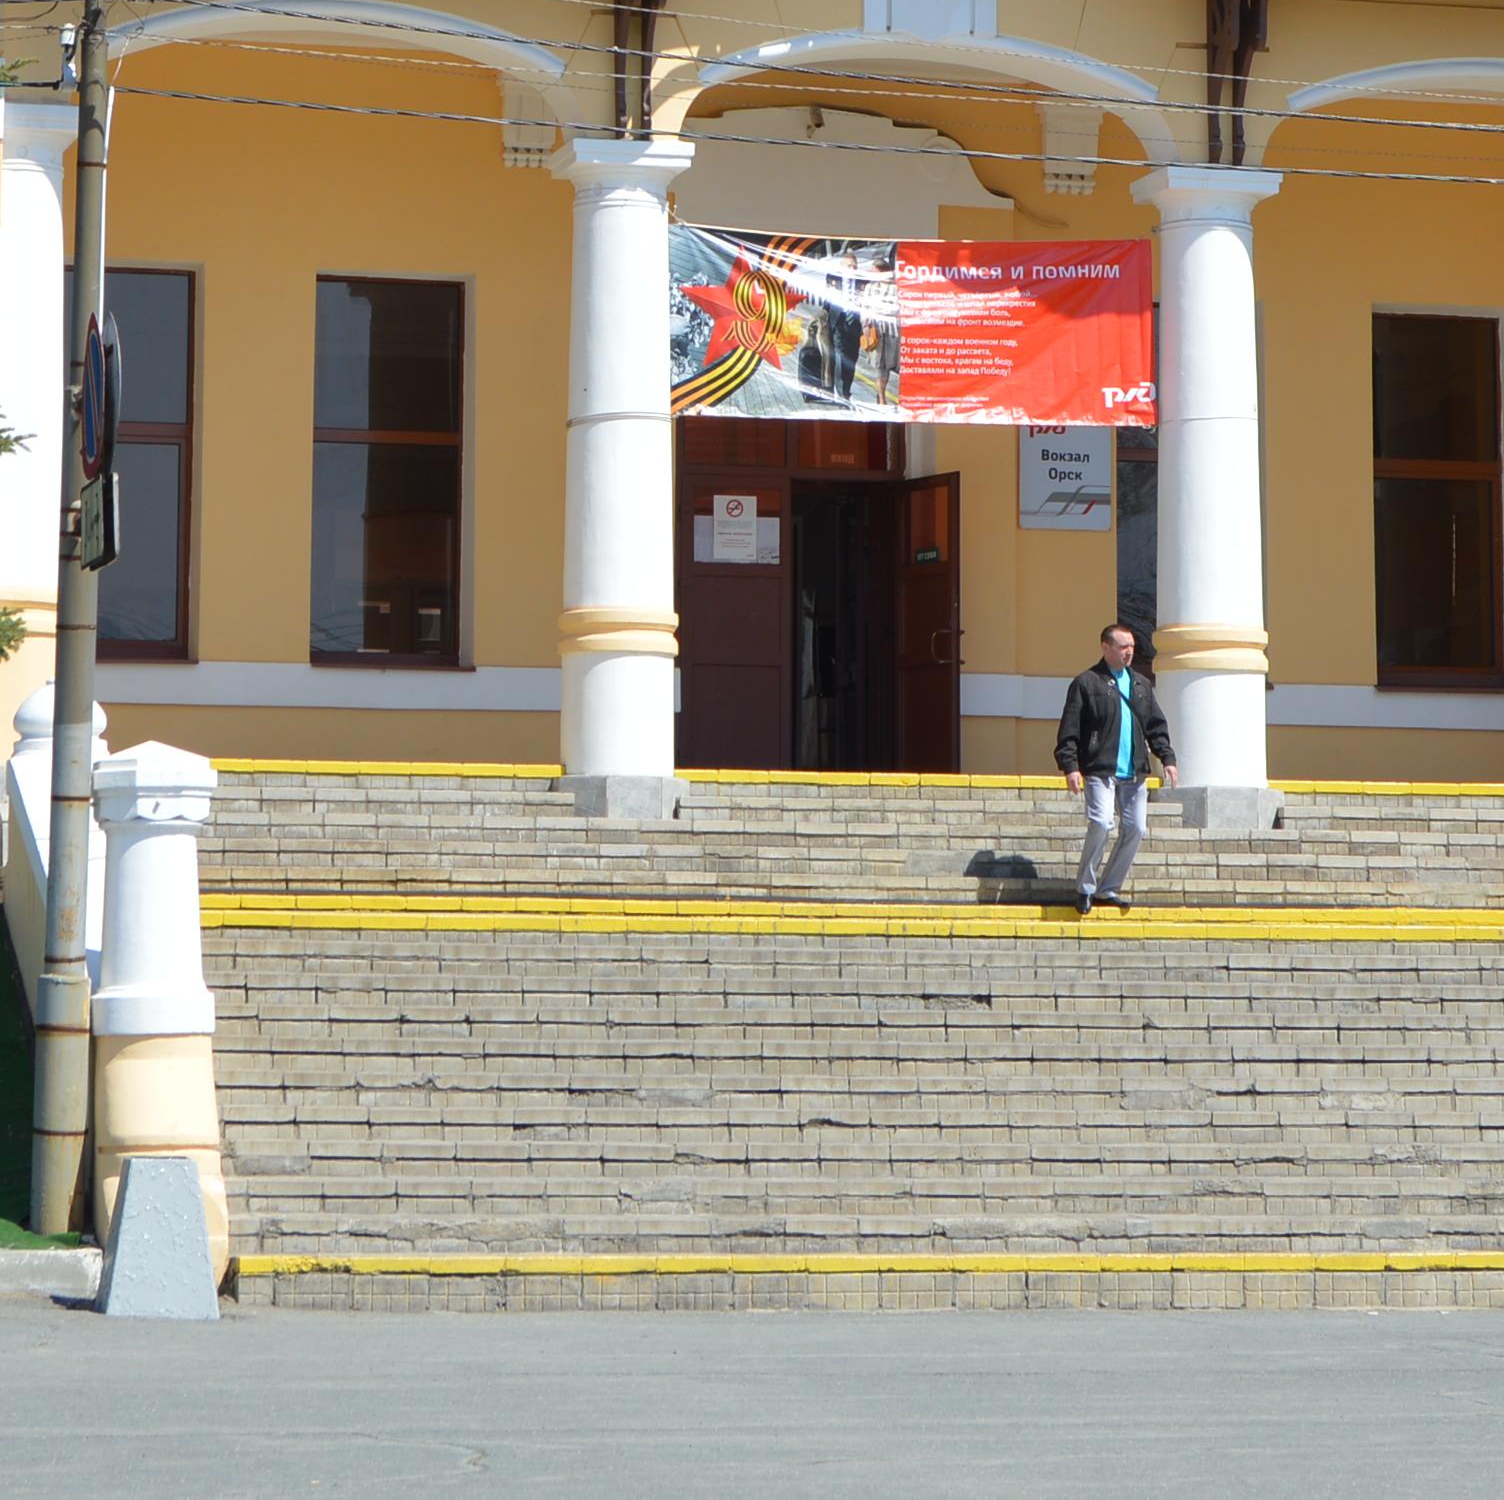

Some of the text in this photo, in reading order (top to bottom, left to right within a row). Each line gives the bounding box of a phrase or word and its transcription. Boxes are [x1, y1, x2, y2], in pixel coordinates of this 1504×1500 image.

[1011, 265, 1025, 280] и
[1032, 264, 1121, 280] помним
[1041, 448, 1091, 464] Вокзал
[1048, 467, 1084, 482] Орск
